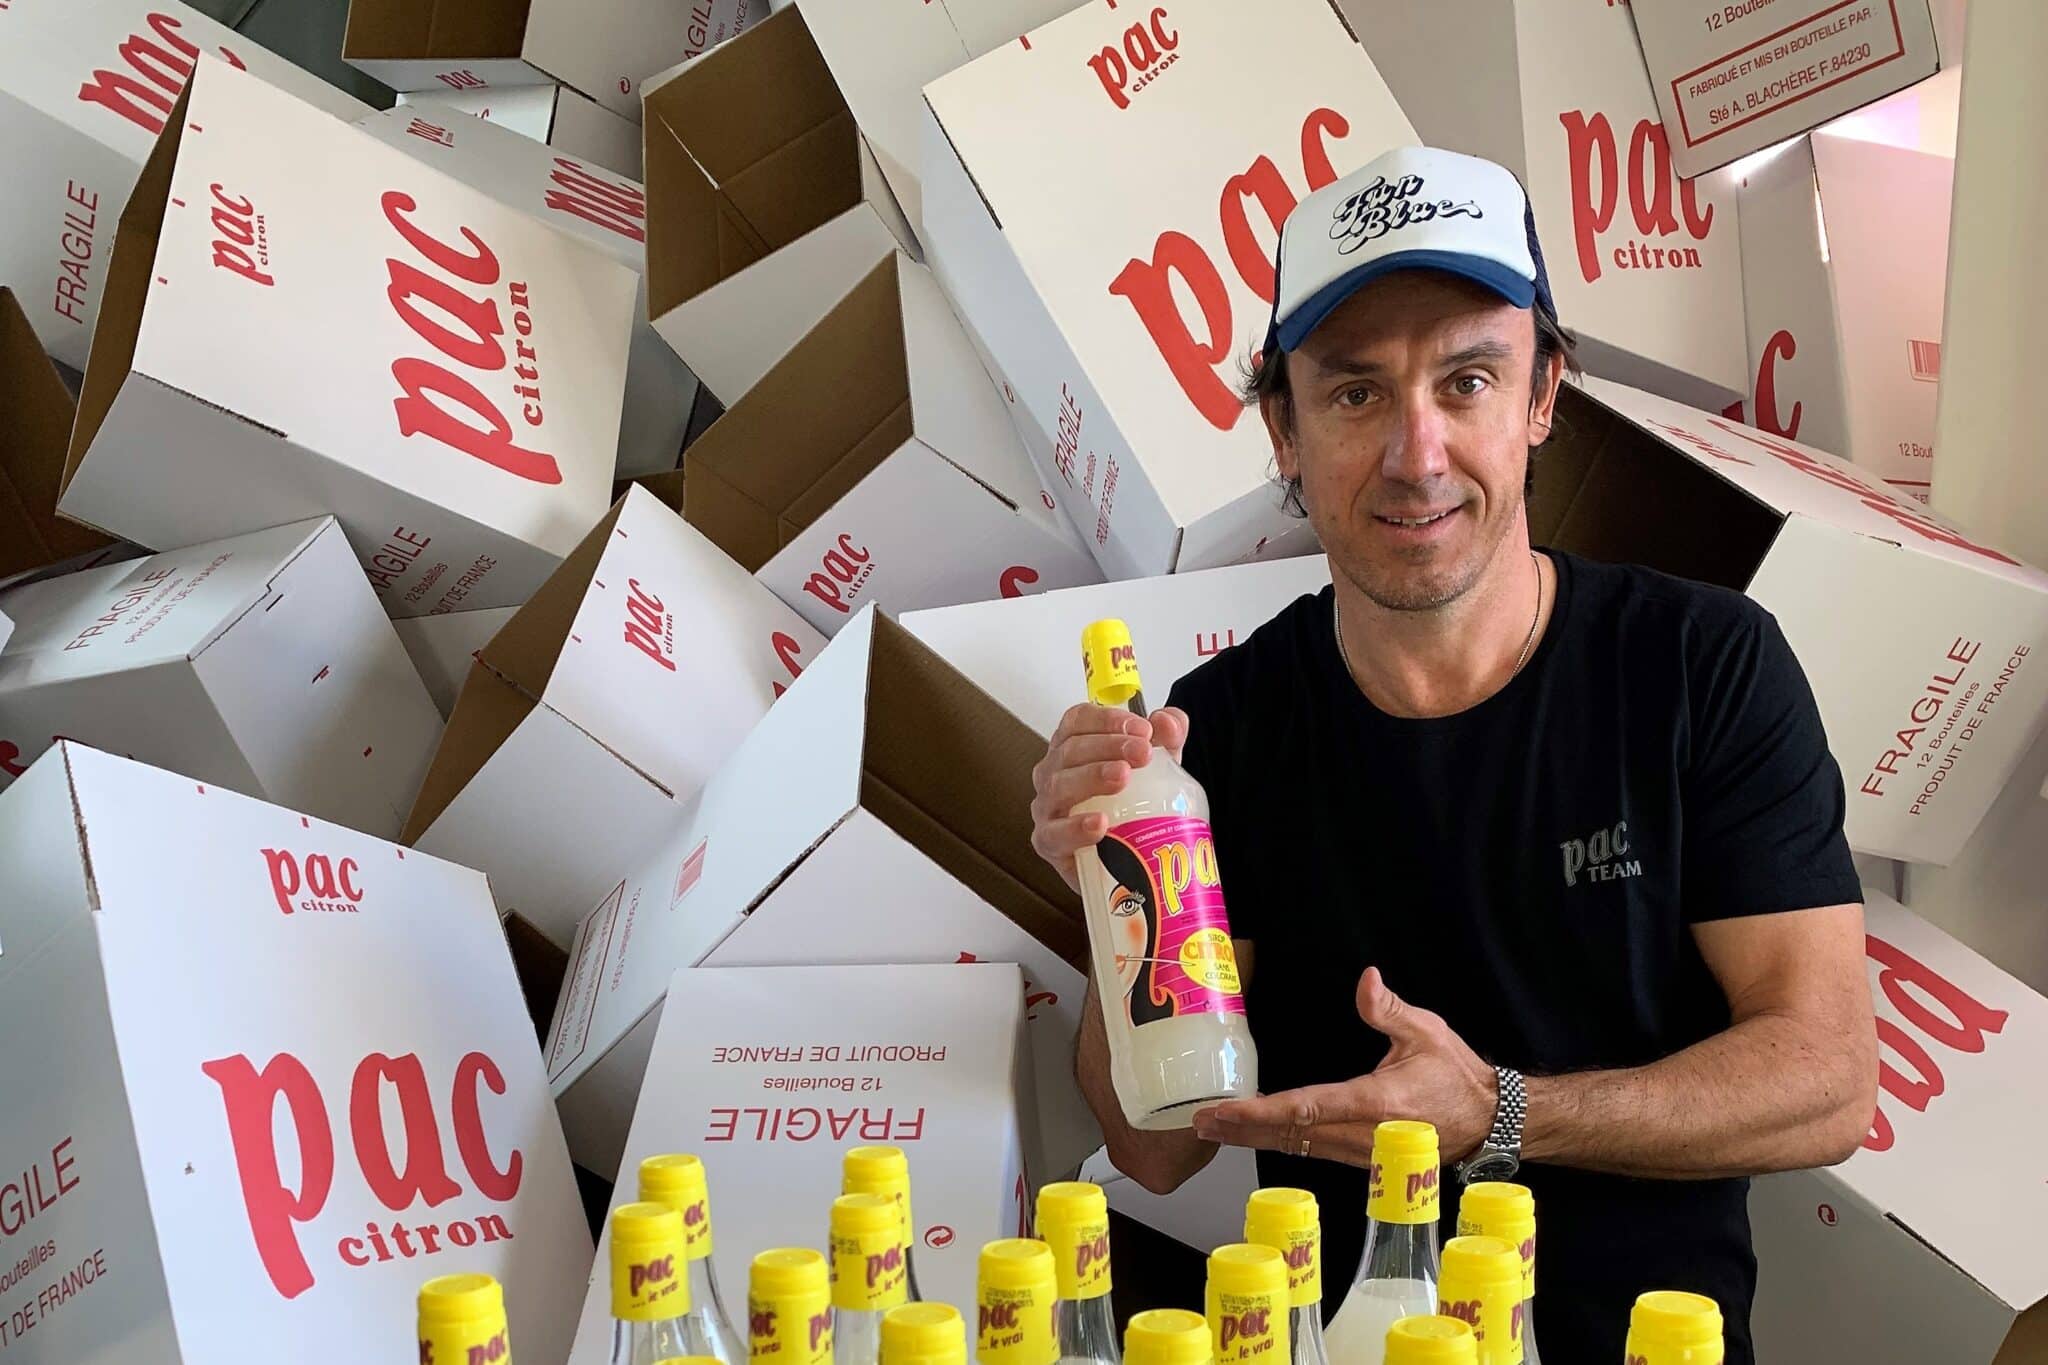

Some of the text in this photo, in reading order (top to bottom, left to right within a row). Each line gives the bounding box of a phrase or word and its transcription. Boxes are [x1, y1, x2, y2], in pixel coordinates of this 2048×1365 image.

[1705, 13, 1723, 32] 12
[1086, 7, 1179, 109] pac
[1131, 51, 1181, 92] citron
[1689, 66, 1739, 99] FABRIQUÉ
[1740, 60, 1752, 76] ET
[1754, 52, 1773, 70] MIS
[1773, 45, 1789, 63] EN
[1789, 18, 1847, 57] BOUTEILLE
[1848, 7, 1871, 28] PAR
[1709, 43, 1871, 125] Sté A. BLACHÈRE F.84230
[55, 179, 99, 325] FRAGILE
[210, 183, 274, 286] pac
[257, 213, 267, 267] citron
[1613, 240, 1702, 269] citron
[381, 190, 562, 485] pac
[512, 280, 544, 427] citron
[1055, 382, 1082, 488] FRAGILE
[362, 526, 431, 599] AGILE
[457, 553, 497, 590] FRANCE
[803, 533, 870, 614] pac
[847, 562, 875, 599] citron
[64, 568, 177, 651] FRAGILE
[450, 582, 468, 601] DE
[624, 578, 677, 672] pac
[663, 613, 674, 655] citron
[1861, 637, 1982, 796] FRAGILE
[1909, 645, 2031, 815] PRODUIT DE FRANCE
[1916, 682, 1980, 769] 12 Bouteilles
[260, 848, 364, 915] pac
[1152, 837, 1221, 916] pa
[1560, 821, 1630, 887] pac
[1587, 860, 1642, 882] TEAM
[301, 899, 360, 913] citron
[1184, 941, 1234, 962] CITRO
[712, 1045, 947, 1063] PRODUIT DE FRANCE
[763, 1077, 883, 1092] 12 Bouteilles
[704, 1107, 926, 1142] FRAGILE
[202, 1051, 523, 1300] pac
[0, 1239, 57, 1294] outeilles
[337, 1213, 515, 1268] citron
[12, 1301, 37, 1338] DE
[38, 1248, 108, 1320] FRANCE
[628, 1254, 674, 1297] pac
[1289, 1276, 1298, 1289] le
[978, 1303, 1020, 1340] pac
[990, 1334, 999, 1350] le
[1001, 1326, 1024, 1348] vrai
[1220, 1307, 1271, 1351] pac
[1239, 1344, 1250, 1360] le
[1253, 1333, 1274, 1356] vrai
